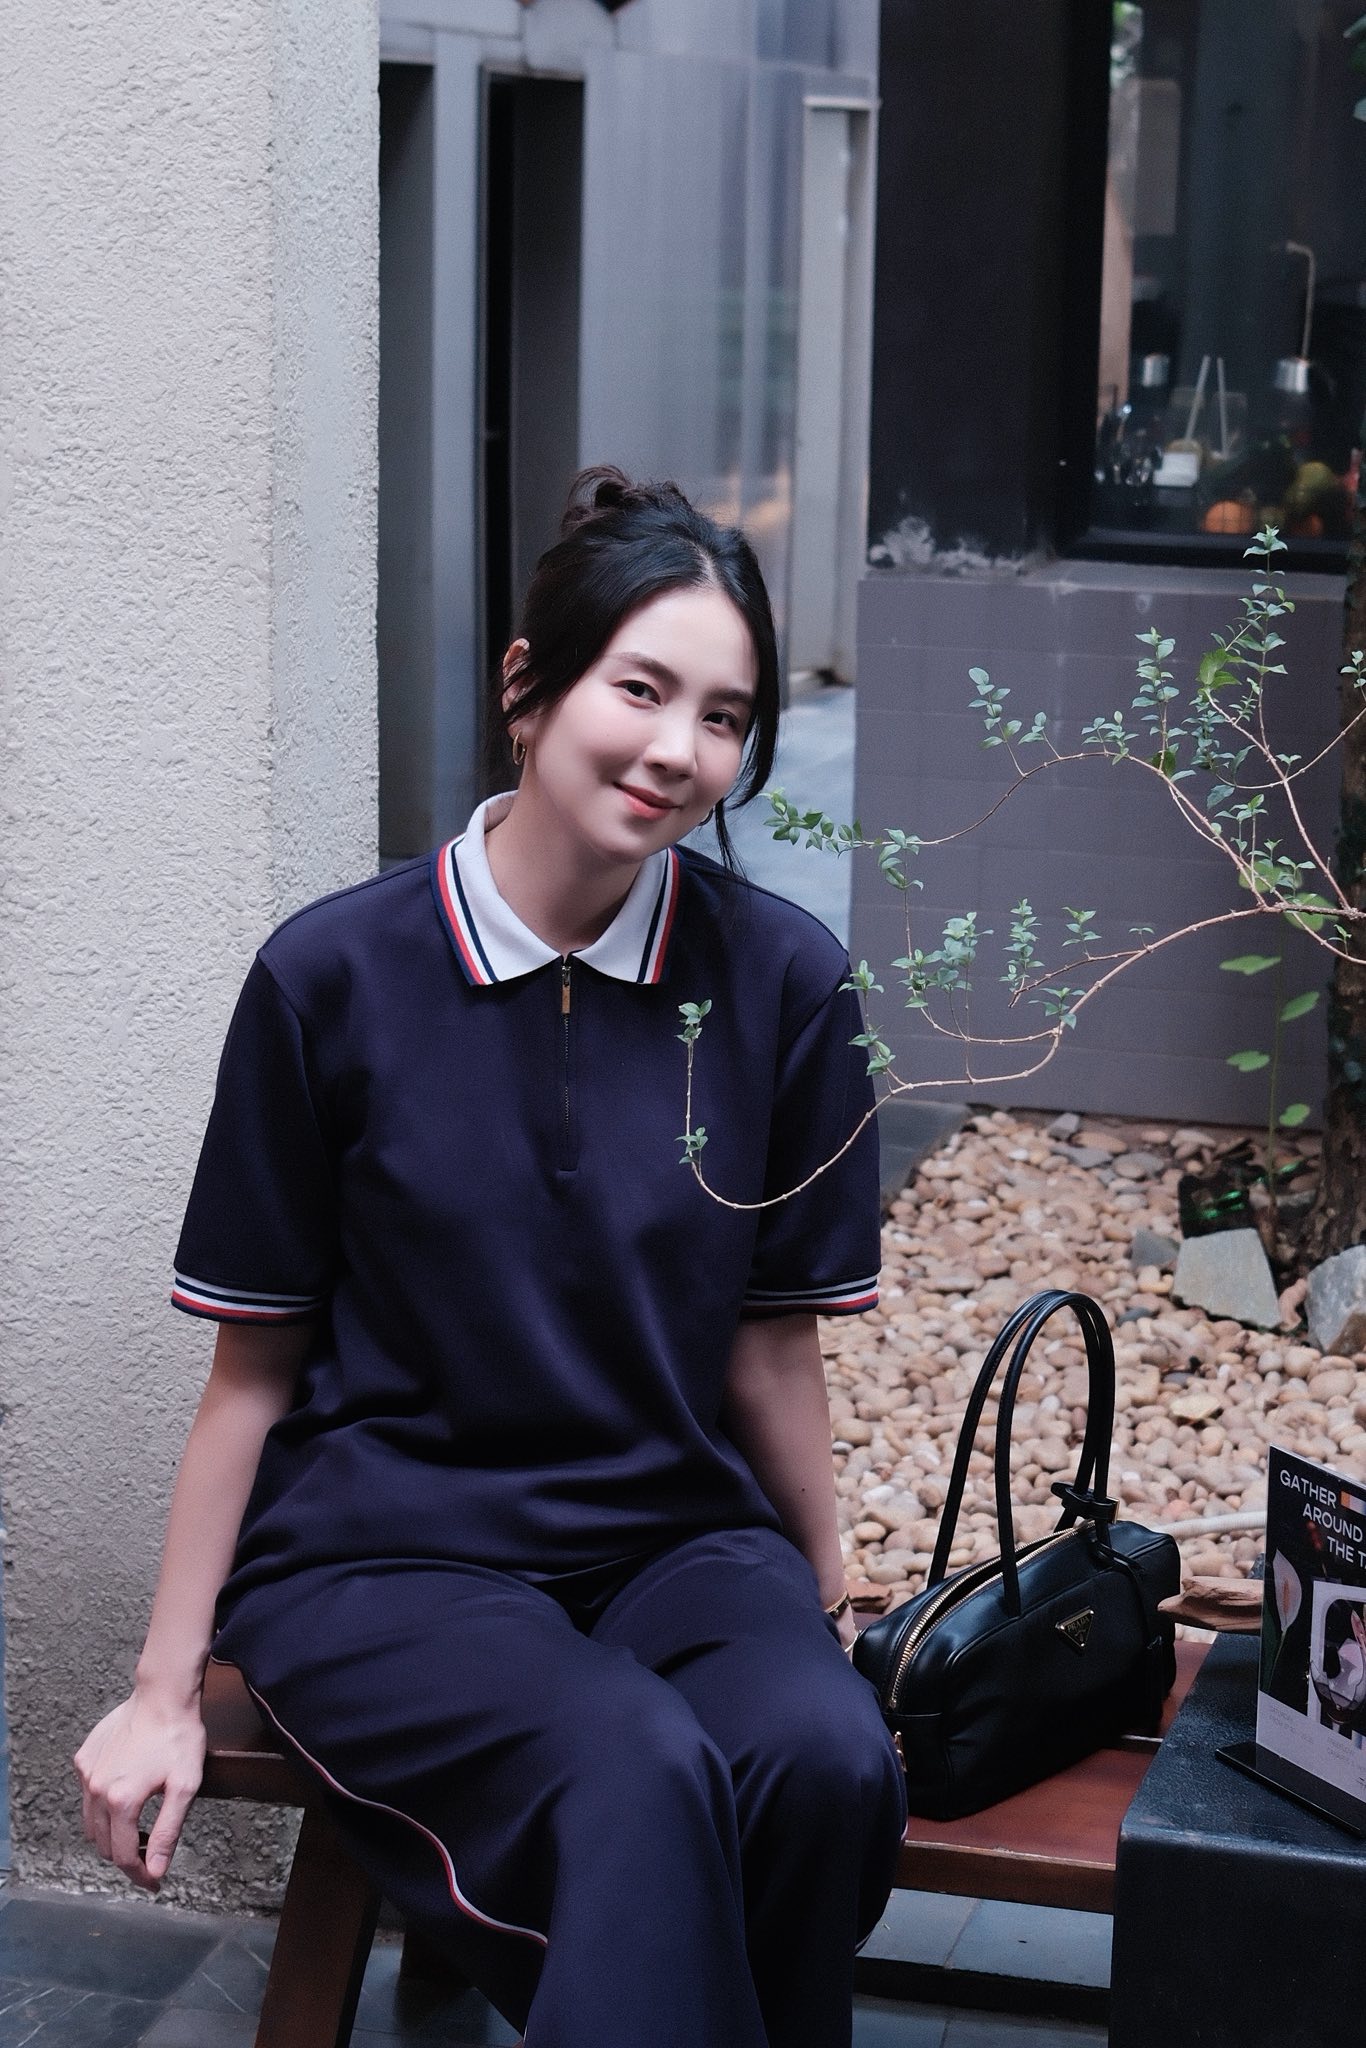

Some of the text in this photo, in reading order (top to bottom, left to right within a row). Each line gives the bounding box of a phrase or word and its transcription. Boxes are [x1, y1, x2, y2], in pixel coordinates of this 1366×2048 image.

[1280, 1469, 1337, 1509] GATHER
[1302, 1503, 1363, 1543] AROUND
[1327, 1535, 1366, 1570] THE T
